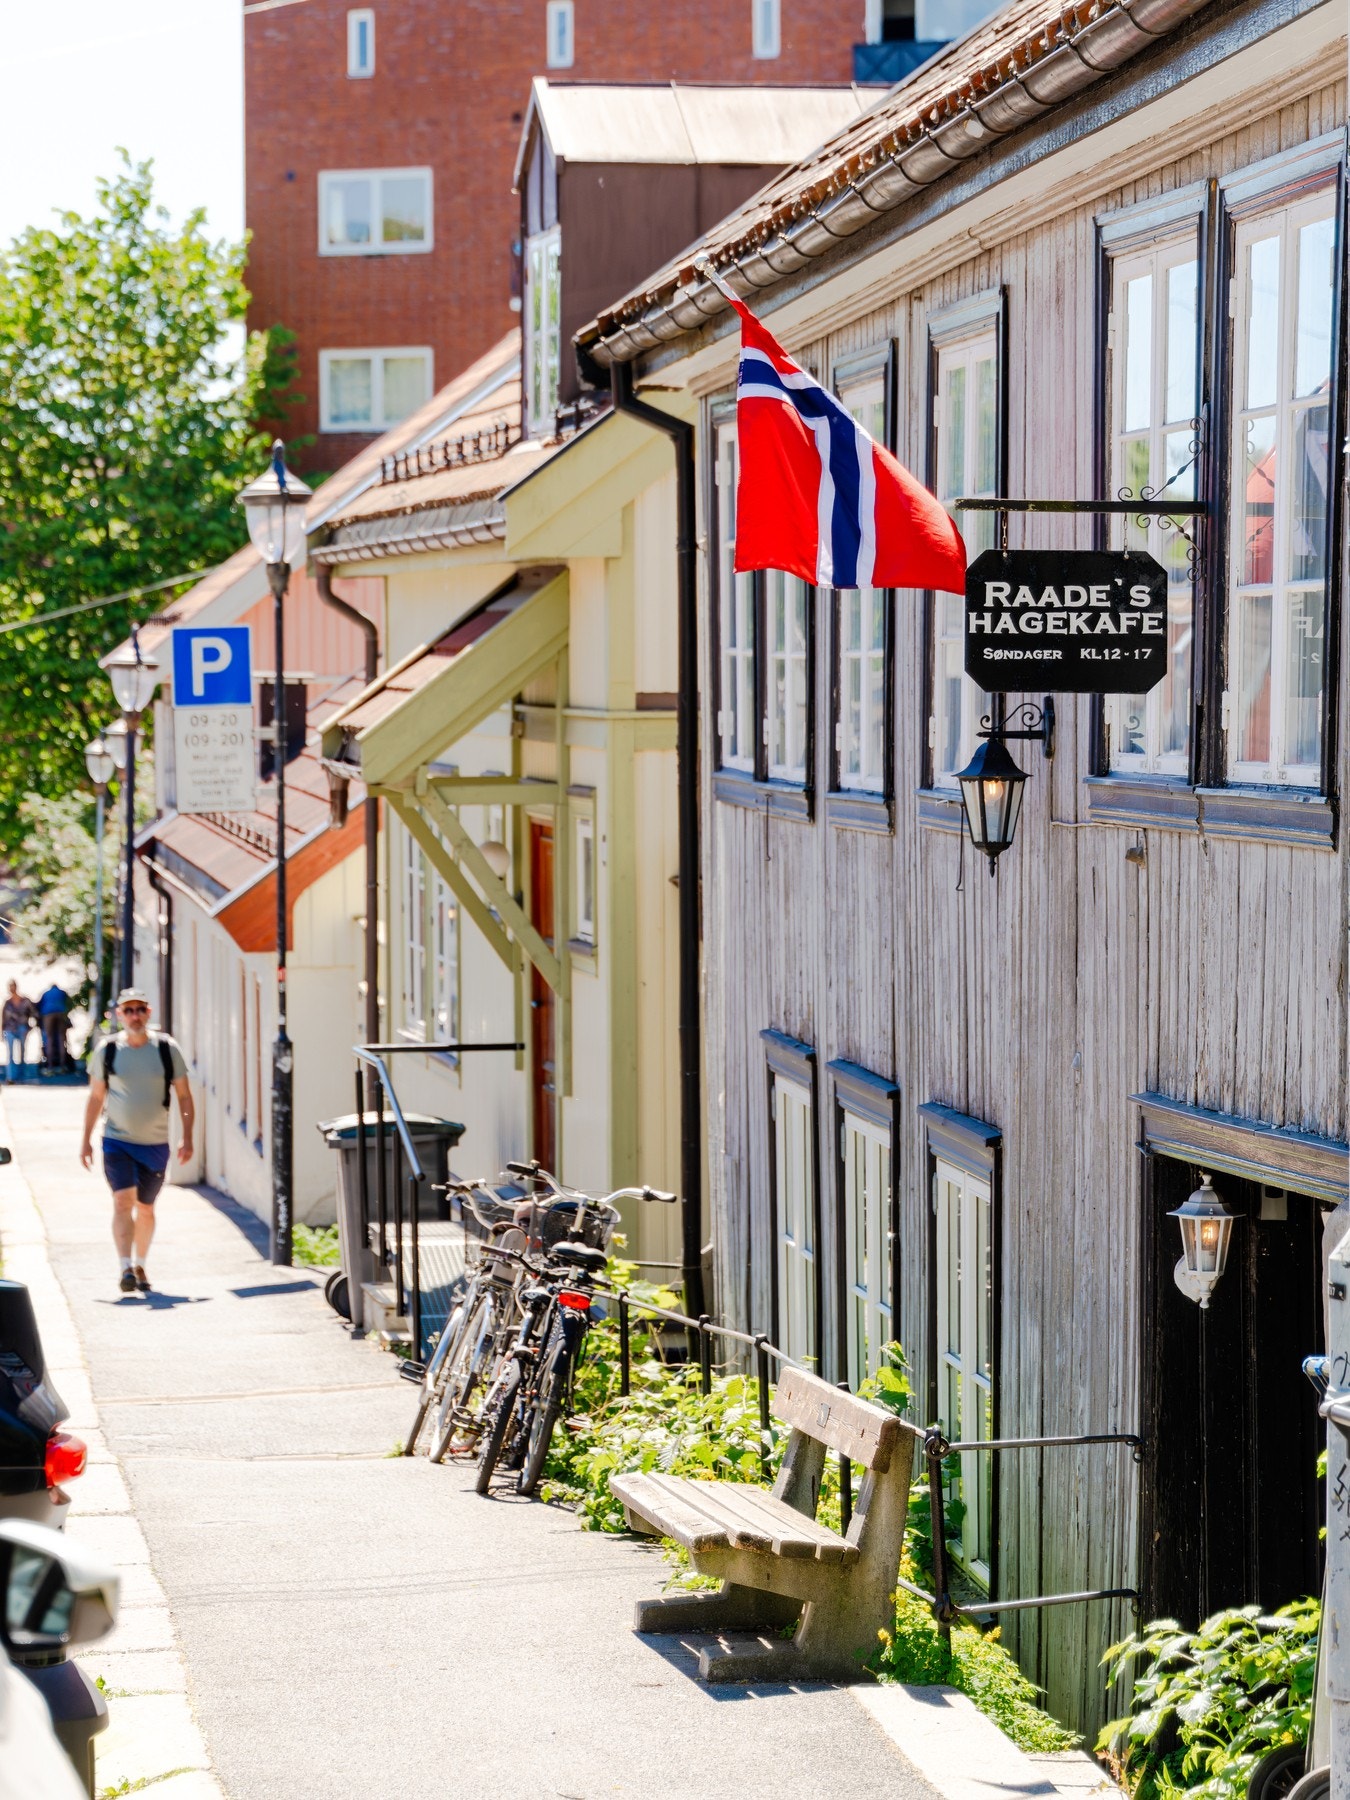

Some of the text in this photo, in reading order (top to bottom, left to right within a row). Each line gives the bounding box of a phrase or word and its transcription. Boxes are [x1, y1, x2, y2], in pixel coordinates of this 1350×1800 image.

[968, 611, 1164, 635] HAGEKAFE
[983, 647, 1063, 660] SØNDAGER
[191, 636, 233, 697] P
